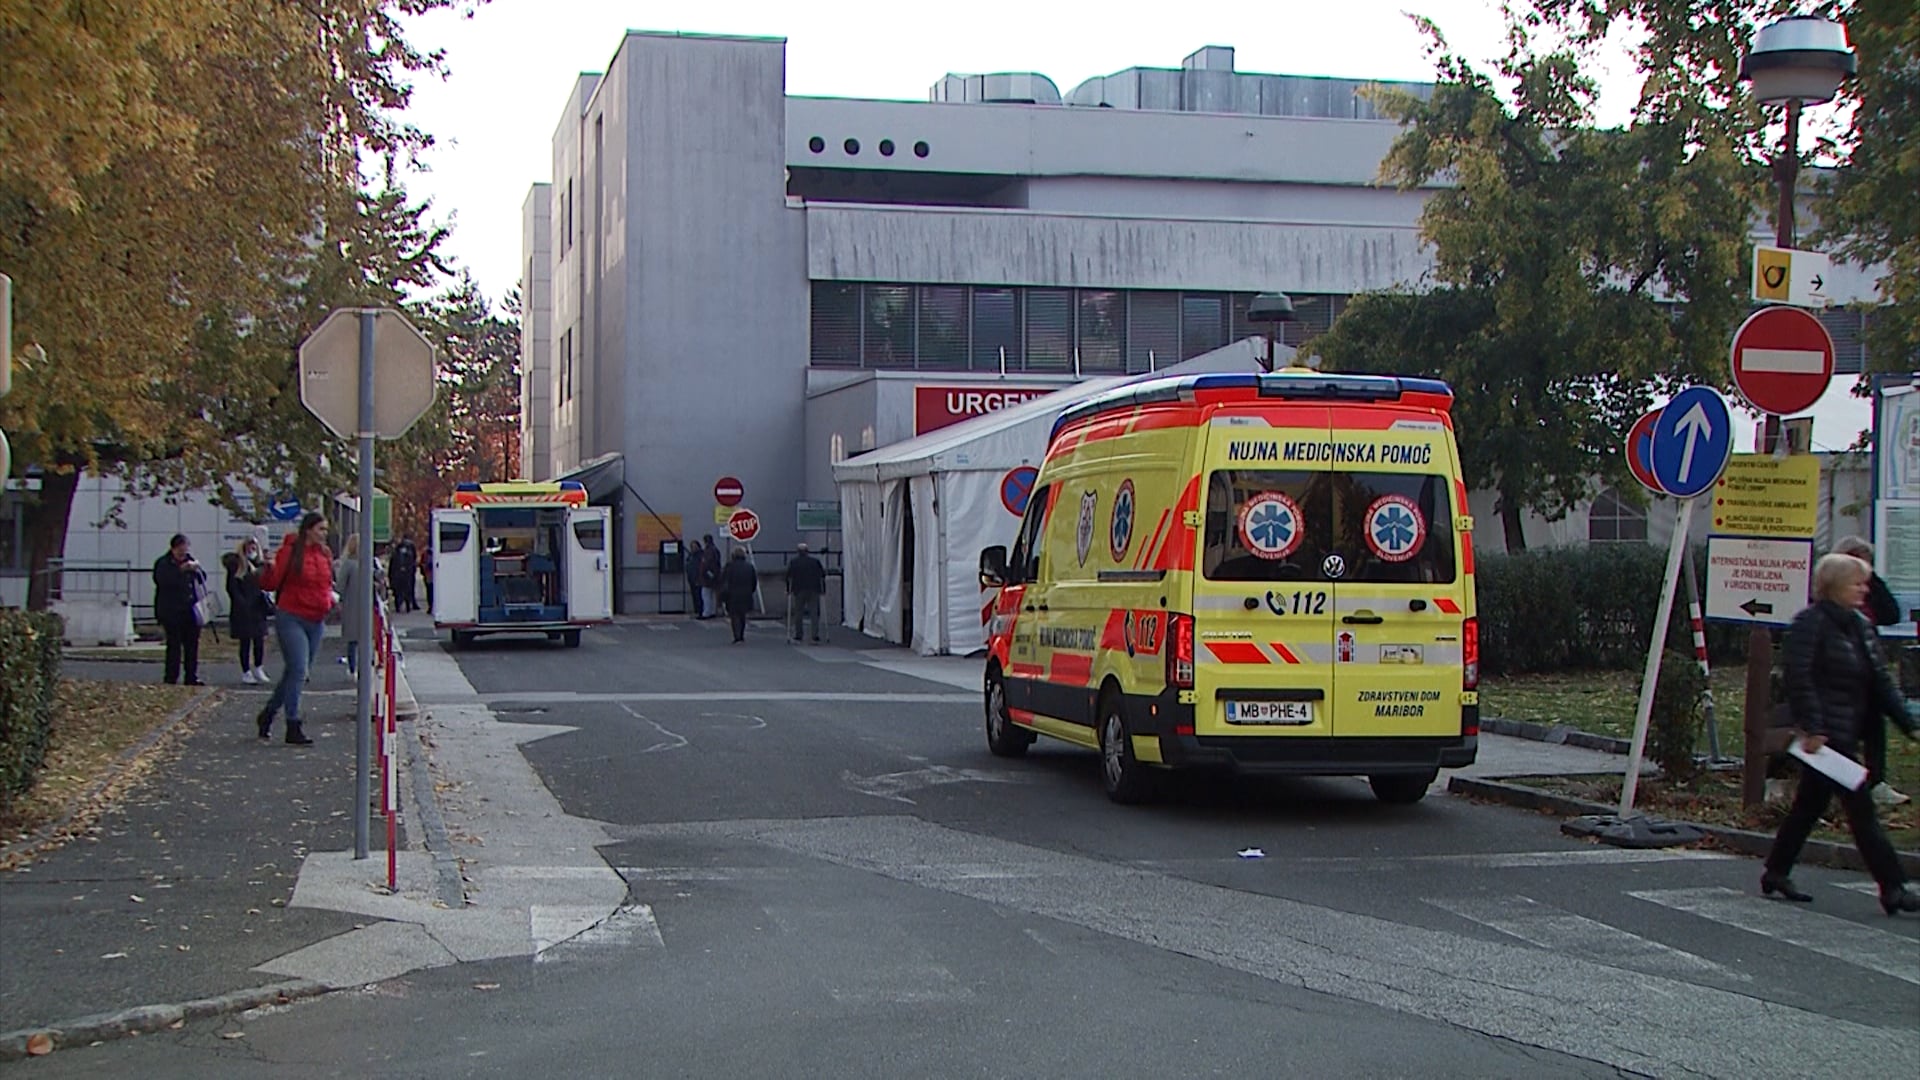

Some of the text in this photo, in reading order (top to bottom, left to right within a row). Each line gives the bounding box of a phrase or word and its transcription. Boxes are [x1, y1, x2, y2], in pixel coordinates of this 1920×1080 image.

[1229, 441, 1431, 464] NUJNA MEDICINSKA POMOČ
[731, 518, 756, 533] STOP
[1711, 556, 1806, 570] INTERNISTIČNA NUJNA POMOČ
[1741, 569, 1783, 580] PRESELJENA
[1764, 582, 1790, 592] CENTER
[1292, 591, 1326, 614] 112
[1139, 615, 1158, 648] 112
[1358, 691, 1440, 702] ZDRAVSTVENI DOM
[1241, 704, 1307, 718] MB PHE-4
[1375, 705, 1424, 717] MARIBOR
